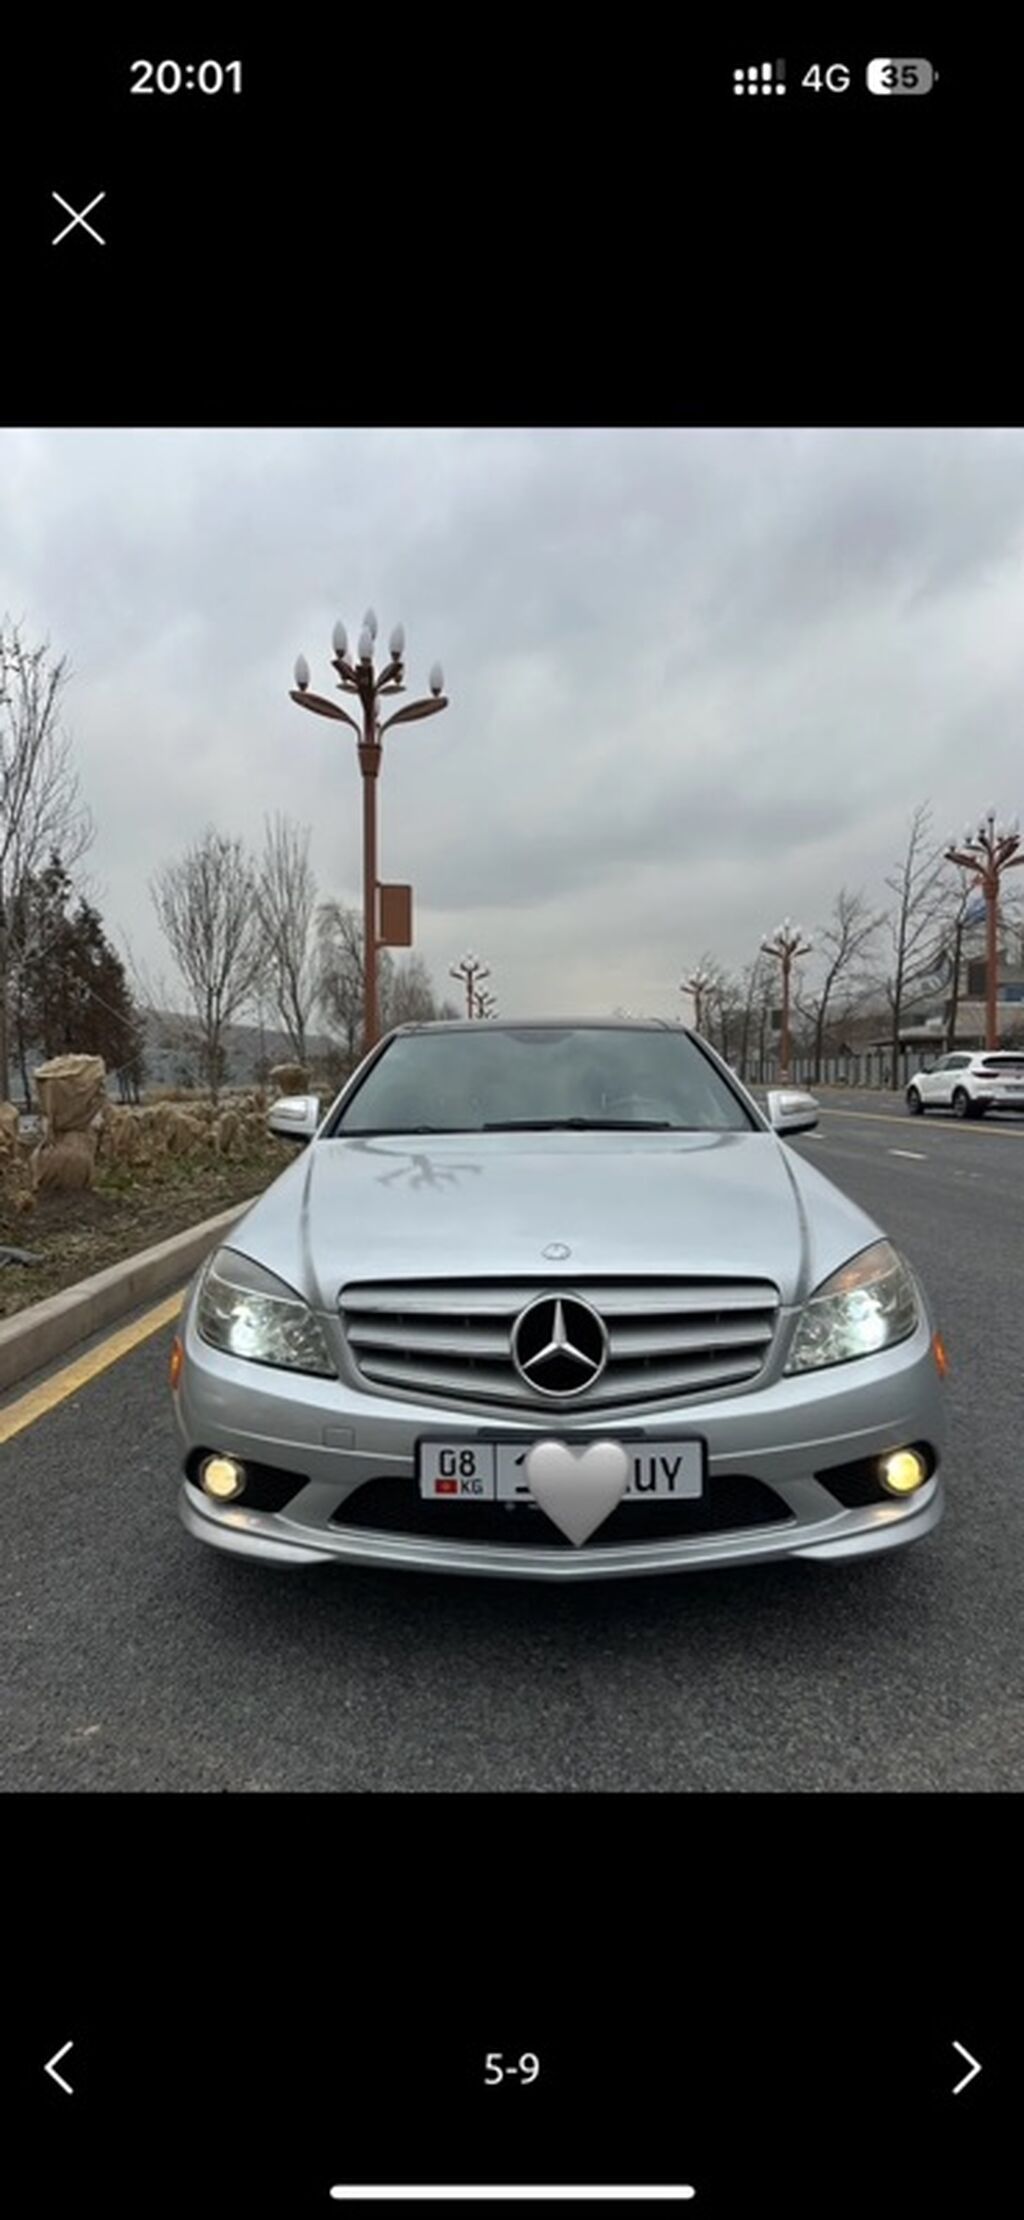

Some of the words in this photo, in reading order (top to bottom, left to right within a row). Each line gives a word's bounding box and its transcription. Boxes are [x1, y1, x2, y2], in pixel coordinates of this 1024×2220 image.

[440, 1449, 476, 1477] 08
[626, 1456, 682, 1493] UY
[461, 1479, 483, 1494] KG
